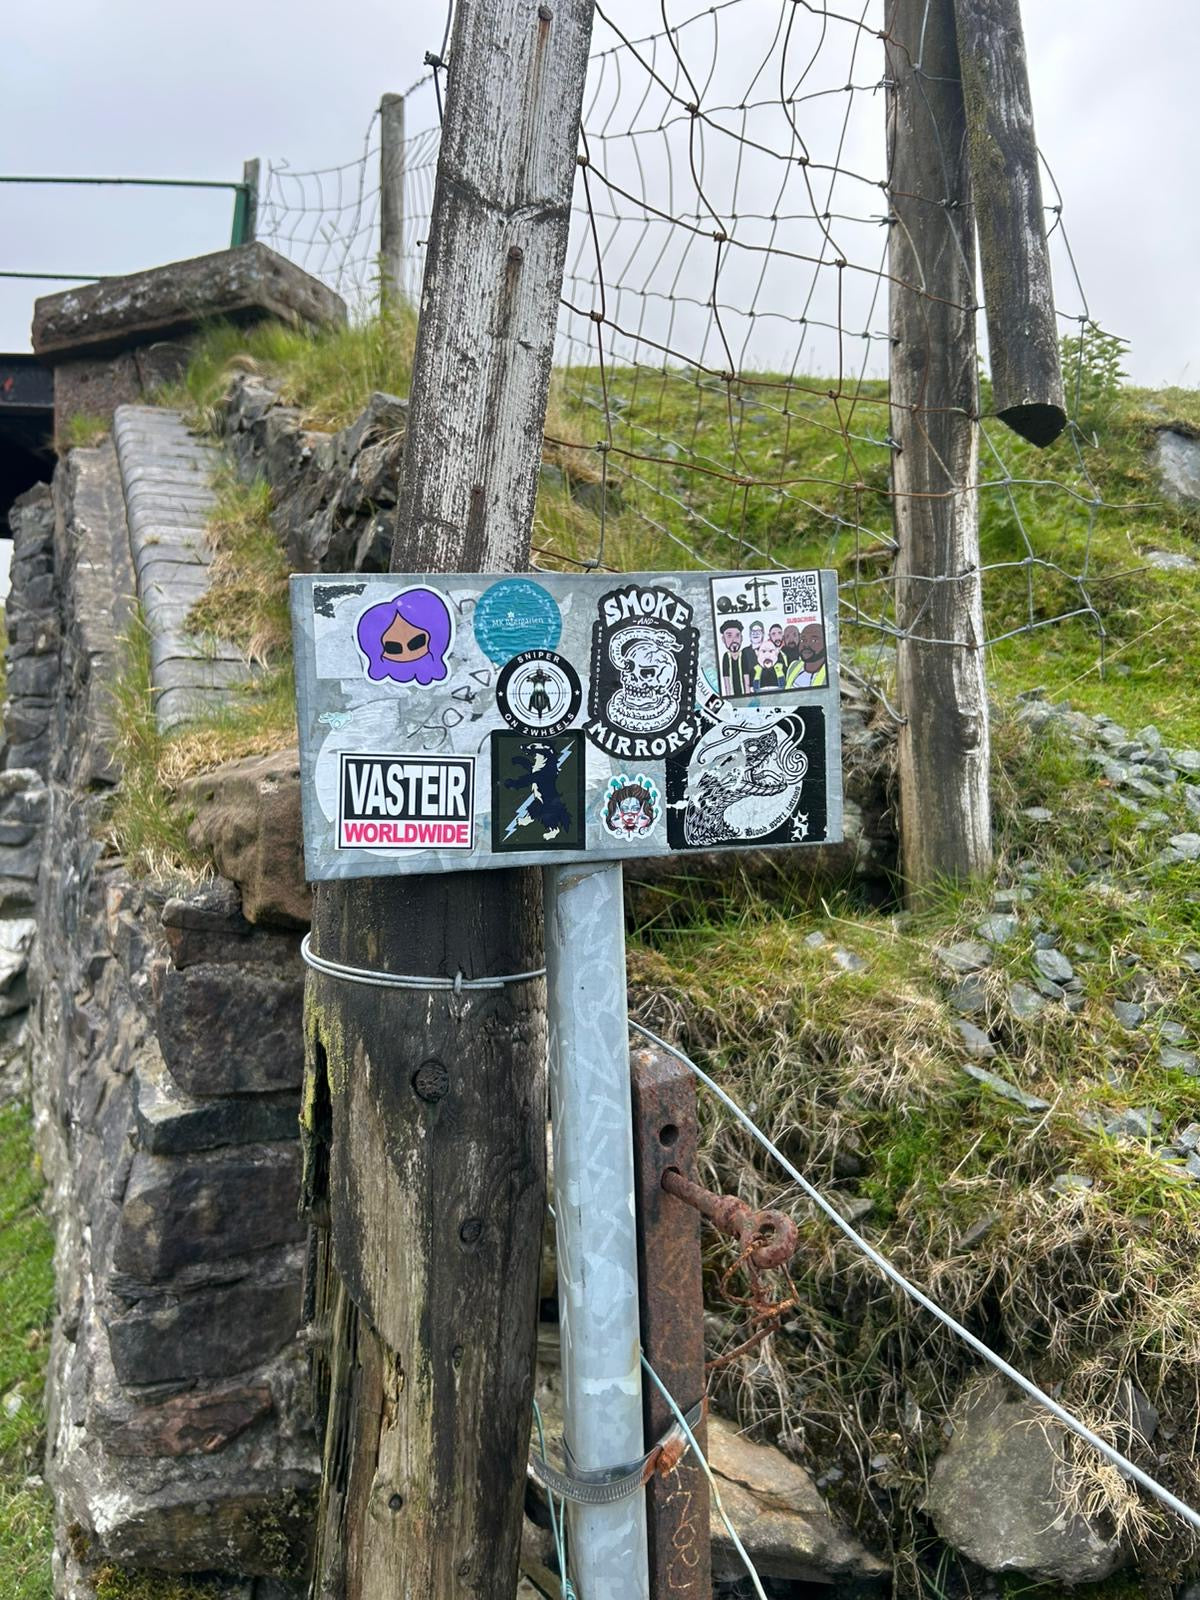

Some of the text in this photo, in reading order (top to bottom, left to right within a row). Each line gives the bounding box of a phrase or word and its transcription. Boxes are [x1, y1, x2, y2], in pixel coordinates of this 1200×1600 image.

[604, 590, 689, 630] SMOKE
[517, 651, 560, 664] SNIPER
[593, 649, 601, 715] TRADITIONAL
[505, 713, 574, 737] ON 2WHEELS
[588, 720, 695, 757] MIRRORS
[347, 763, 467, 817] VASTEIR
[745, 825, 767, 837] Blood
[786, 786, 801, 812] tattoos
[344, 822, 469, 844] WORLDWIDE
